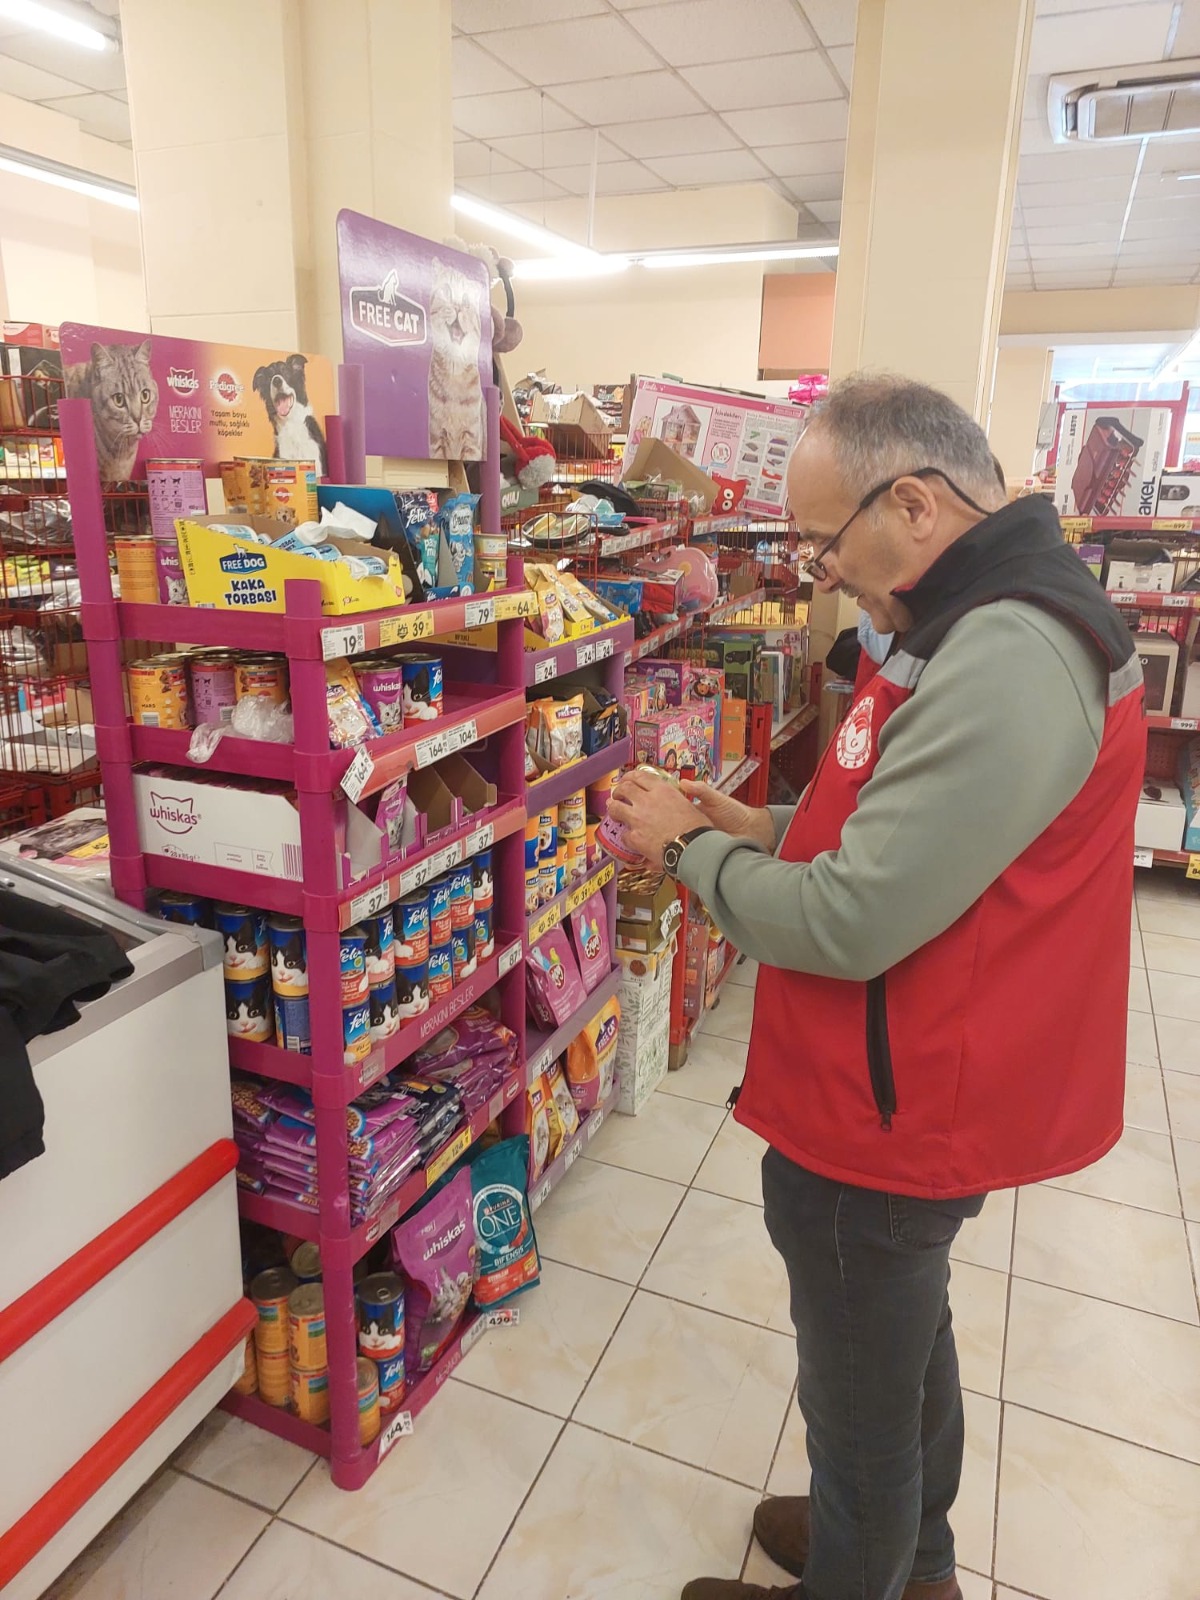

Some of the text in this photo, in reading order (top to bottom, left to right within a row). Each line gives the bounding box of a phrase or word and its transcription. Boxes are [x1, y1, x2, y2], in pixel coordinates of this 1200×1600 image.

[359, 300, 420, 335] FREE CAT
[166, 374, 199, 389] whiskas
[232, 410, 247, 419] boyu
[170, 419, 202, 434] BESLER
[222, 557, 265, 570] FREE DOG
[231, 579, 265, 592] KAKA
[224, 590, 277, 605] TORBASI
[478, 608, 489, 624] 79
[517, 601, 529, 615] 64
[412, 621, 425, 637] 39
[343, 635, 357, 654] 19
[584, 651, 592, 663] 24
[544, 665, 553, 680] 24
[459, 730, 472, 744] 104
[429, 743, 443, 758] 164
[150, 806, 198, 826] whiskas
[478, 833, 489, 849] 37
[446, 851, 457, 868] 37
[415, 868, 427, 887] 37
[368, 896, 382, 914] 37
[509, 950, 518, 966] 87
[479, 1209, 520, 1238] ONE
[423, 1220, 467, 1262] whiskas
